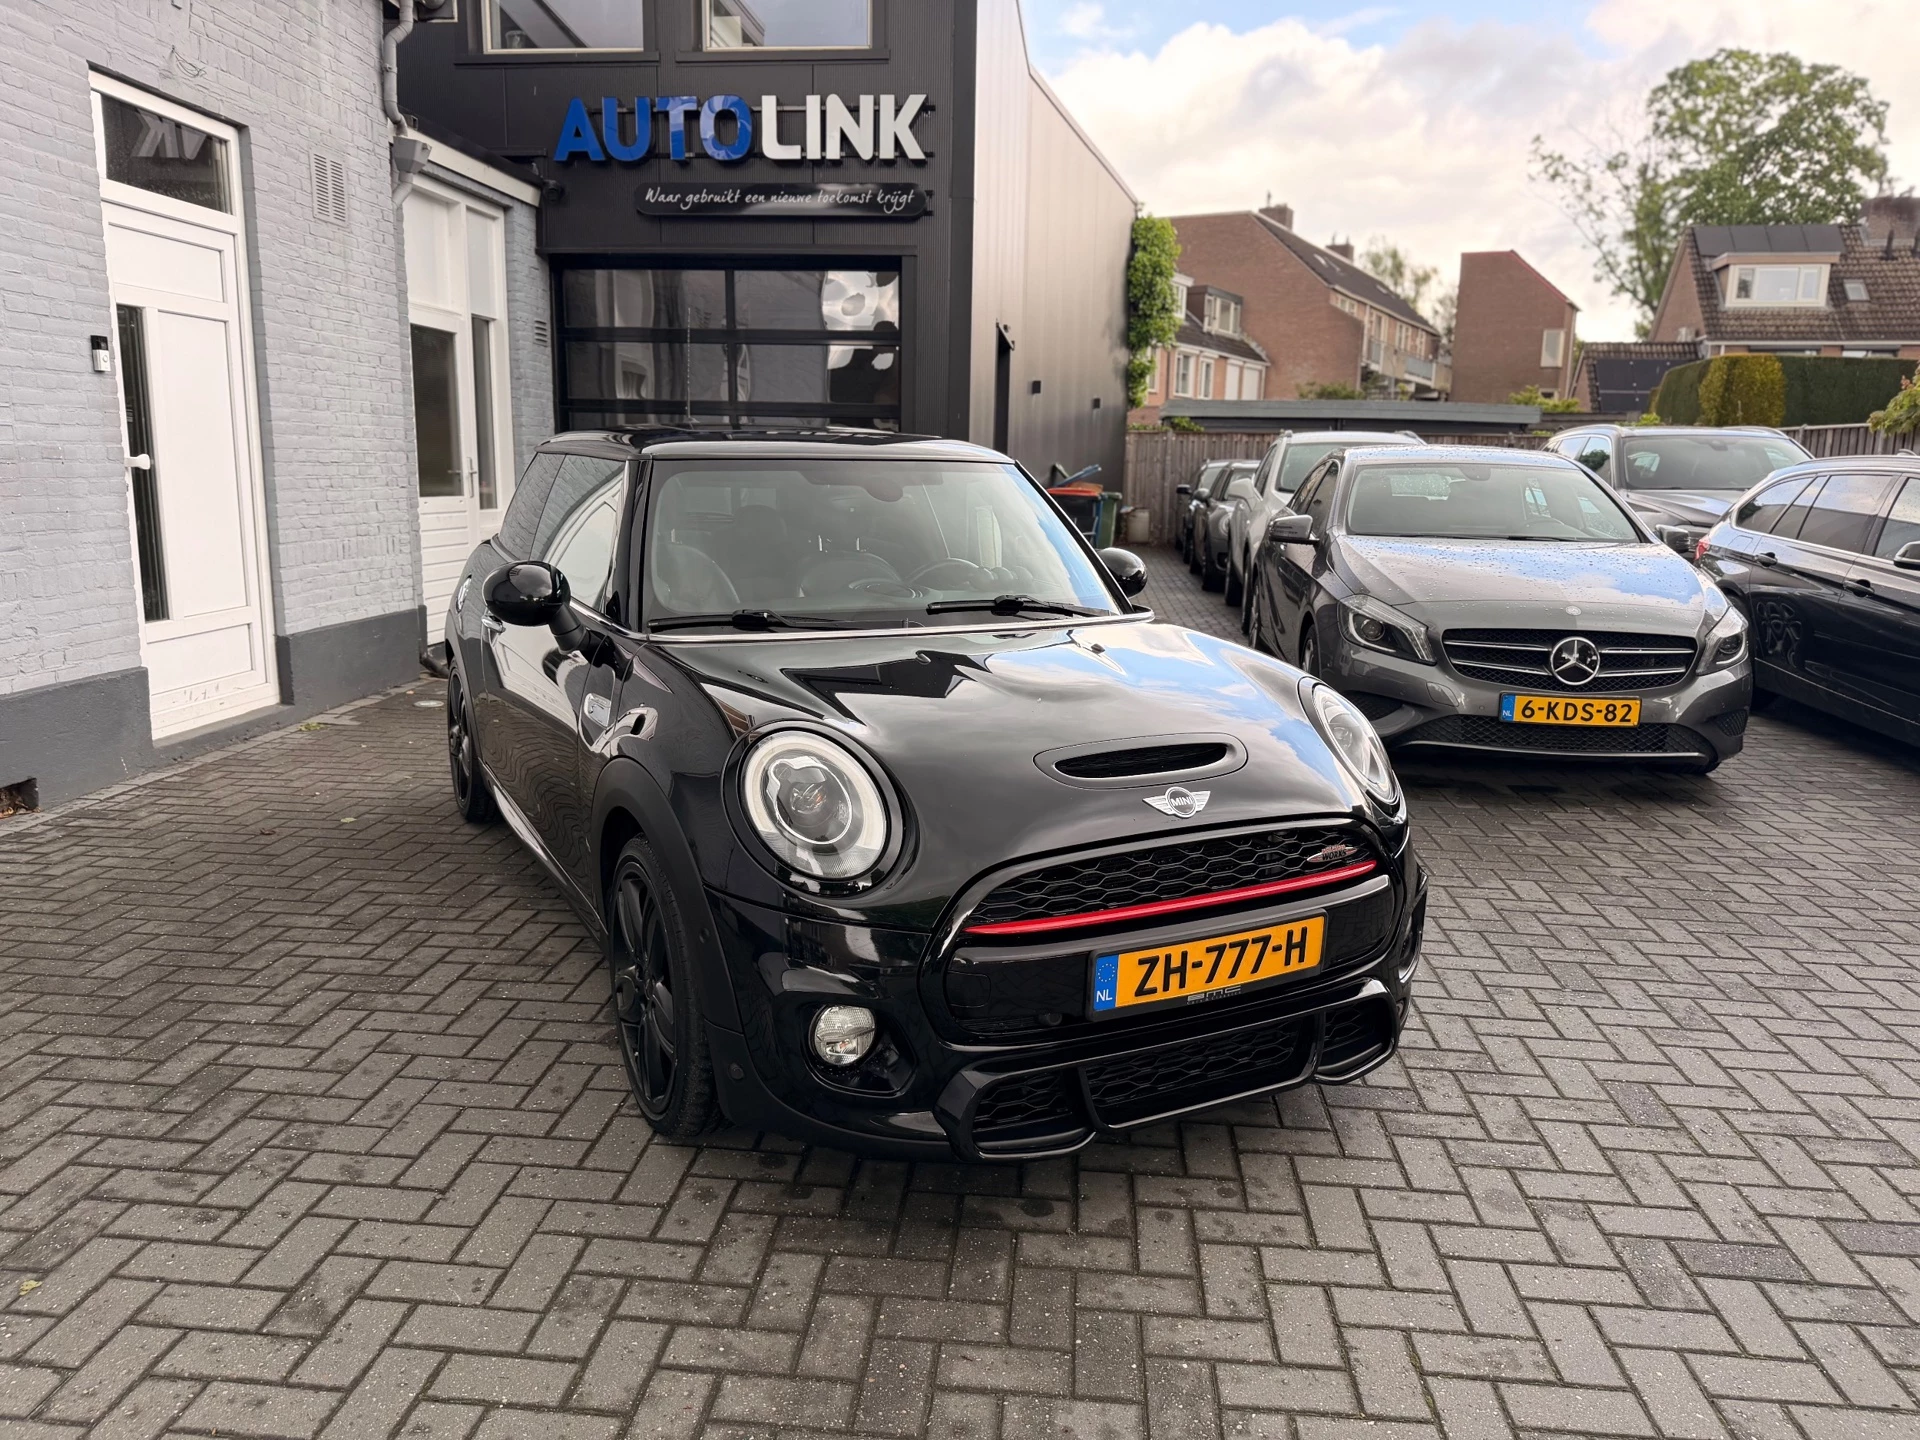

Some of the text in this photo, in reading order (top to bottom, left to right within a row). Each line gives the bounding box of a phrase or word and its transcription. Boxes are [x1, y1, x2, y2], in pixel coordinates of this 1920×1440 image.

[645, 187, 915, 214] Waar gebruikt een nieuwe toekomst krijgt
[1502, 709, 1513, 718] NL
[1520, 699, 1633, 723] 6-KDS-82
[1170, 796, 1194, 807] MINI
[1321, 849, 1347, 861] WORKS
[1134, 926, 1308, 997] ZH-777-H
[1096, 988, 1113, 1003] NL
